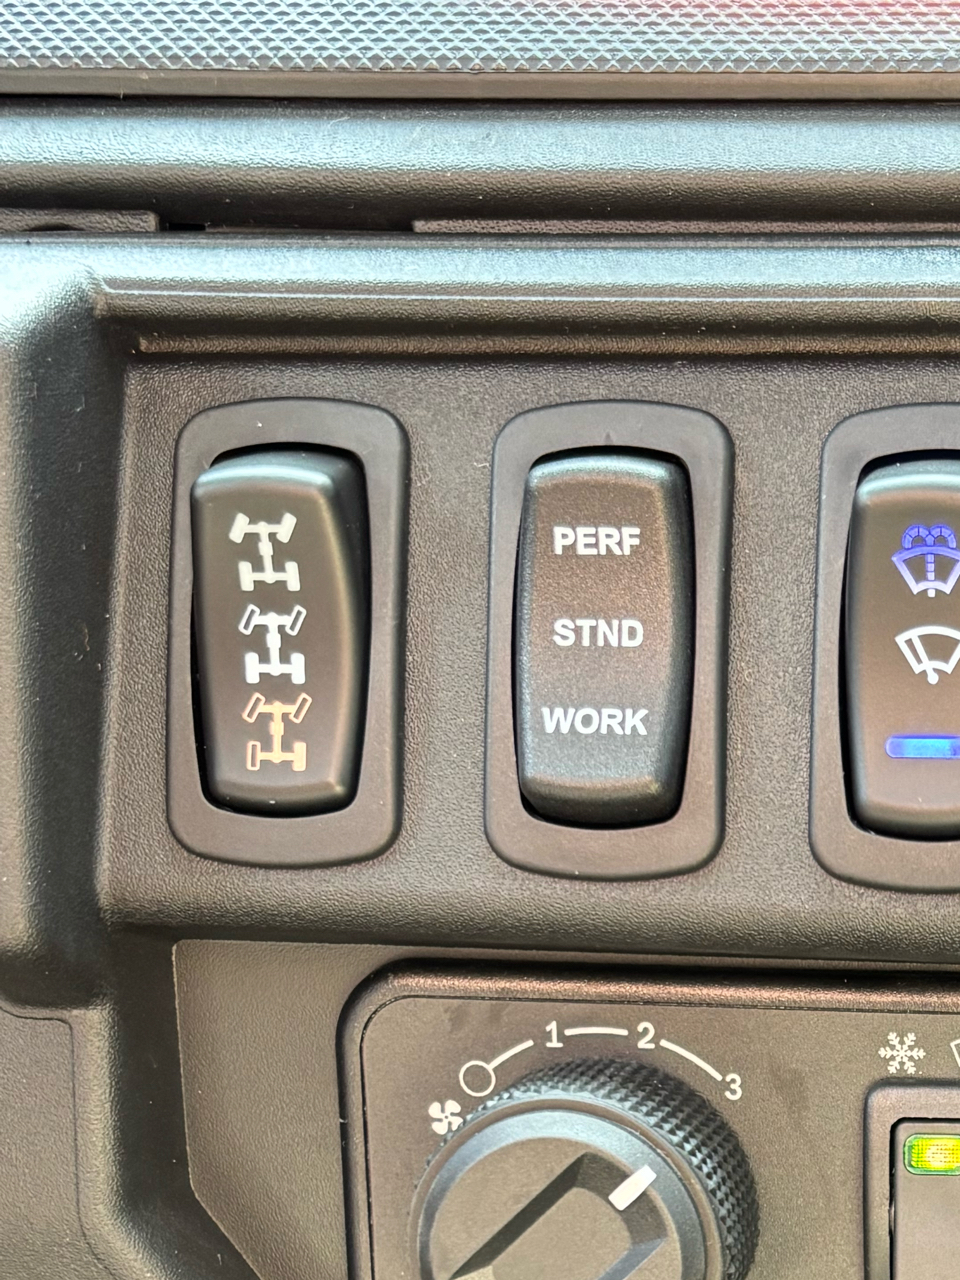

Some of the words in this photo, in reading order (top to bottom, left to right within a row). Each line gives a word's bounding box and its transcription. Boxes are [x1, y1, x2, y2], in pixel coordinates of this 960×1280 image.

[552, 526, 641, 555] PERF
[552, 618, 644, 647] STND
[541, 706, 649, 735] WORK
[545, 1020, 564, 1048] 1
[636, 1021, 656, 1050] 2
[724, 1072, 743, 1102] 3
